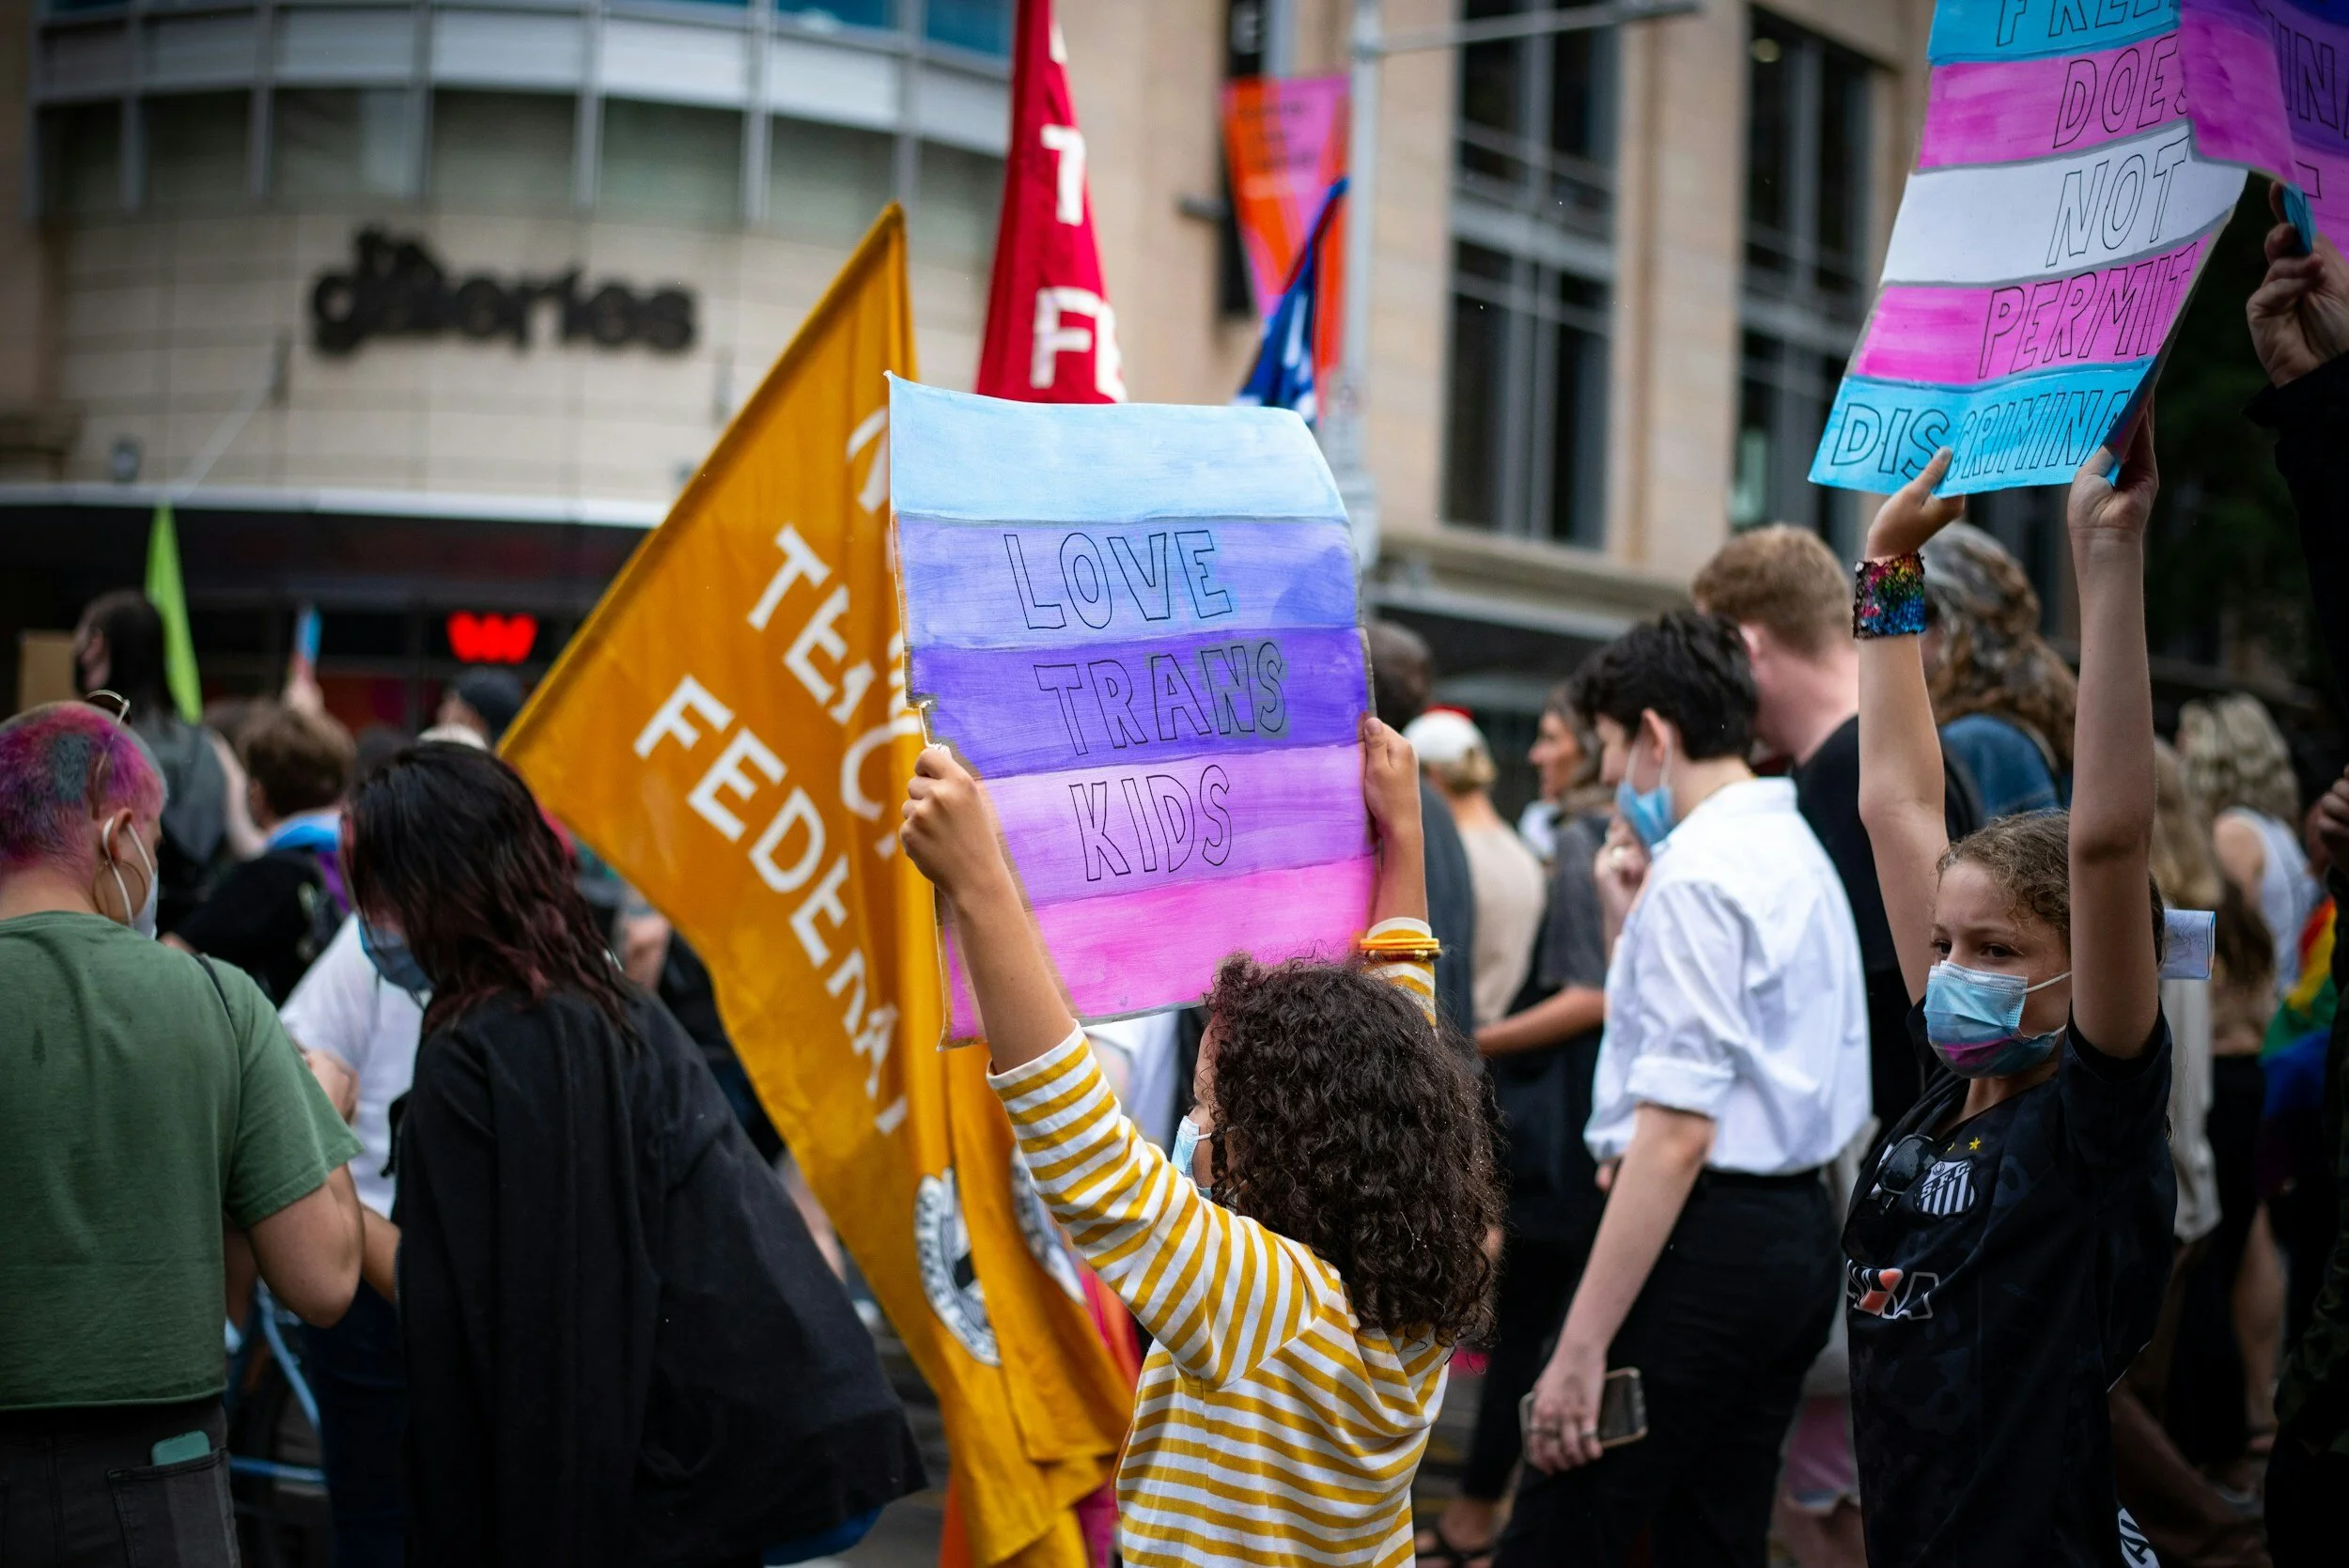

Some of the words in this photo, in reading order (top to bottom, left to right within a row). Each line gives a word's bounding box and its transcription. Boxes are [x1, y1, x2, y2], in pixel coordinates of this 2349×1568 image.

[2046, 134, 2190, 268] NOT
[1978, 241, 2198, 379] PERMIT
[1003, 530, 1233, 629] LOVE
[1034, 642, 1286, 755] TRANS
[1068, 765, 1233, 881] KIDS
